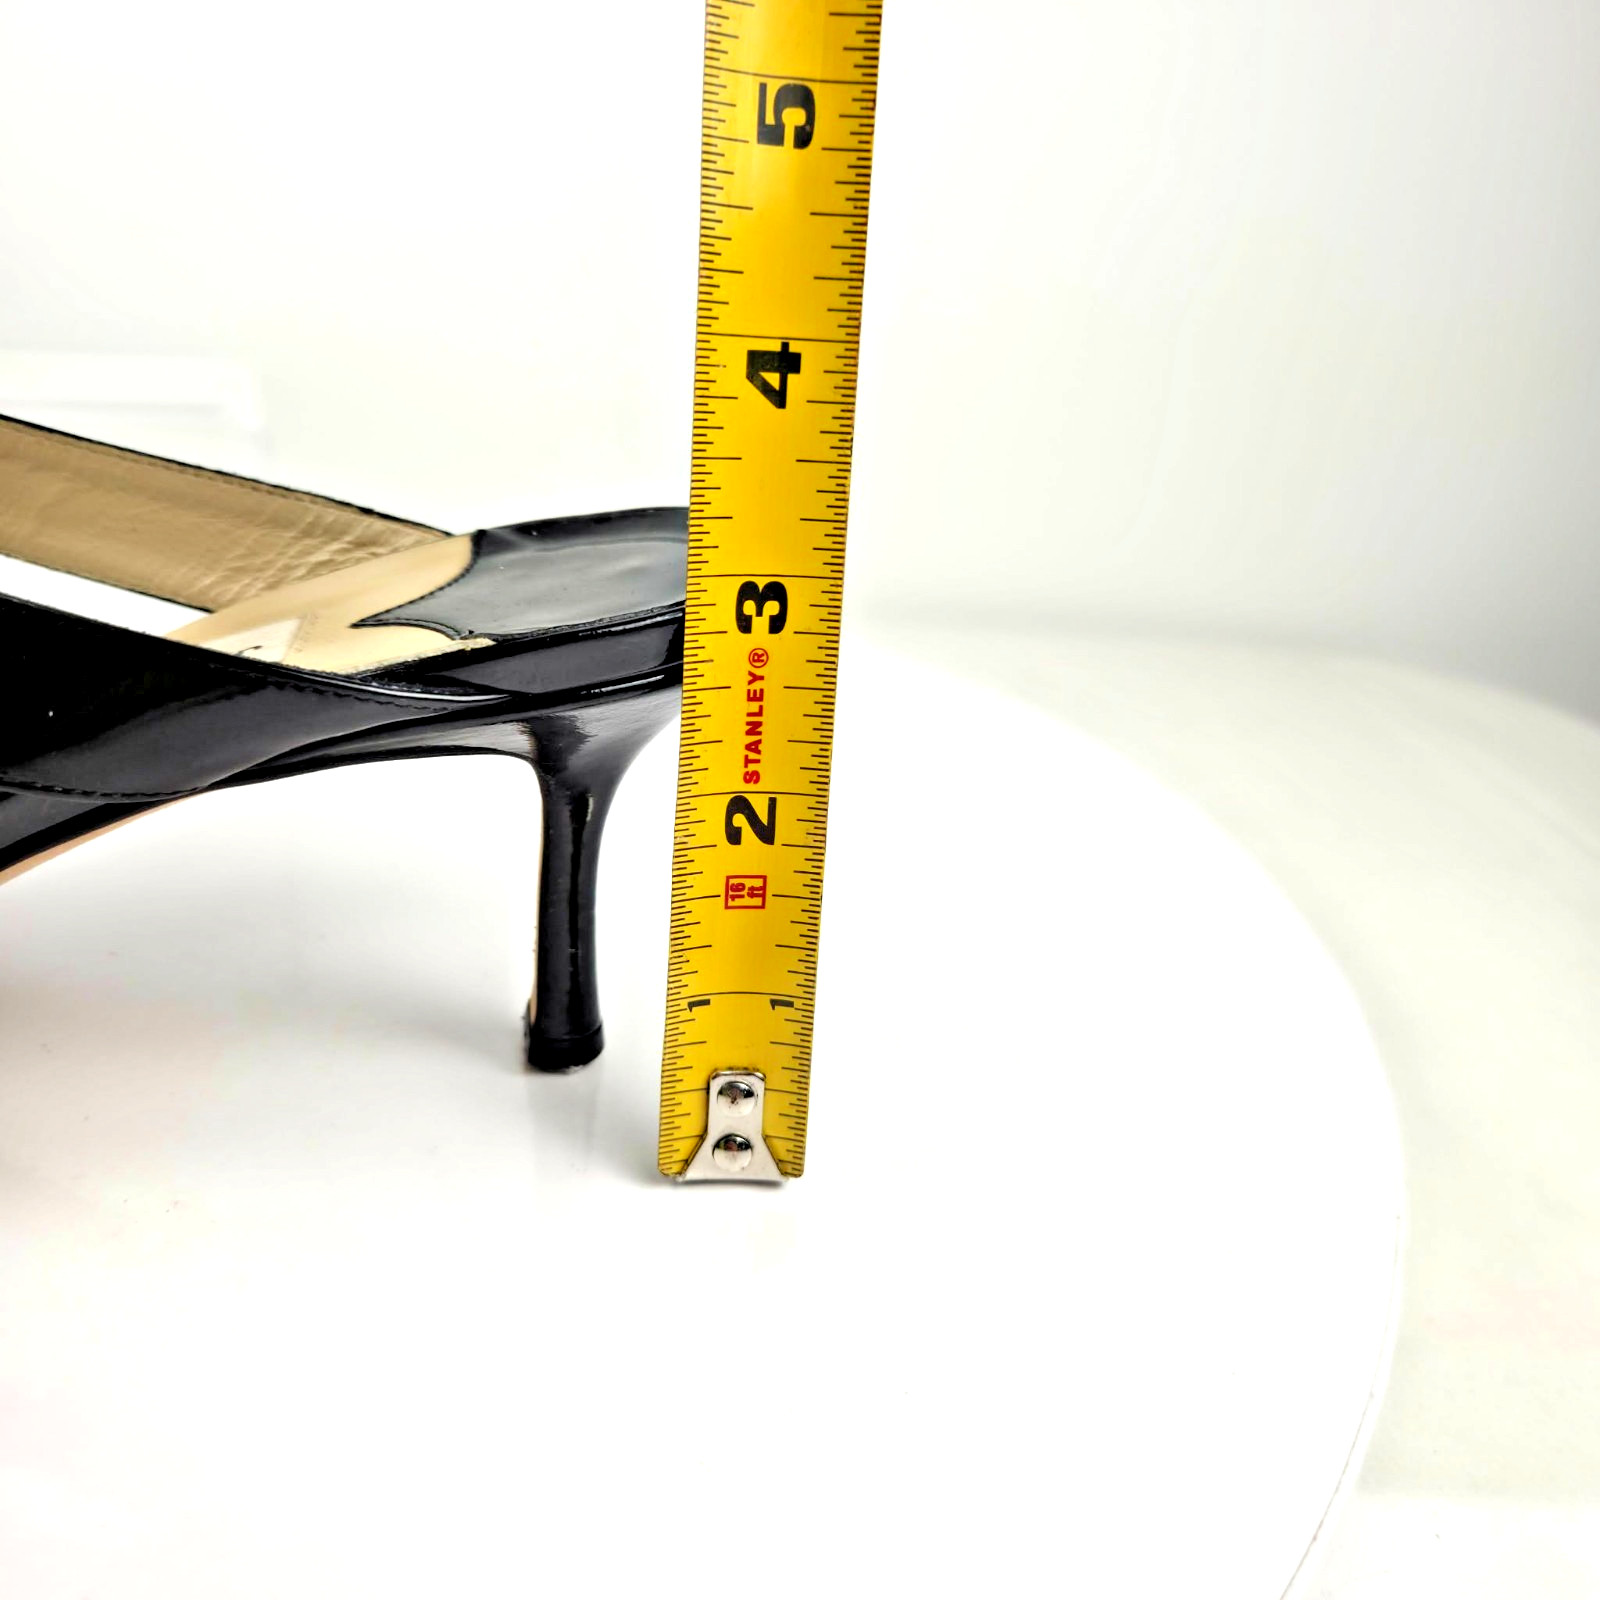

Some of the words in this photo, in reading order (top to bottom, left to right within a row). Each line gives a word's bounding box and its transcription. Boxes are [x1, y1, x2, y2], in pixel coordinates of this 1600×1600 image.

[756, 82, 816, 149] 5
[746, 341, 801, 409] 4
[735, 580, 788, 634] 3
[724, 794, 777, 845] 2
[729, 882, 746, 901] 16
[746, 884, 764, 901] ft
[687, 999, 711, 1012] 1
[770, 999, 795, 1010] 1
